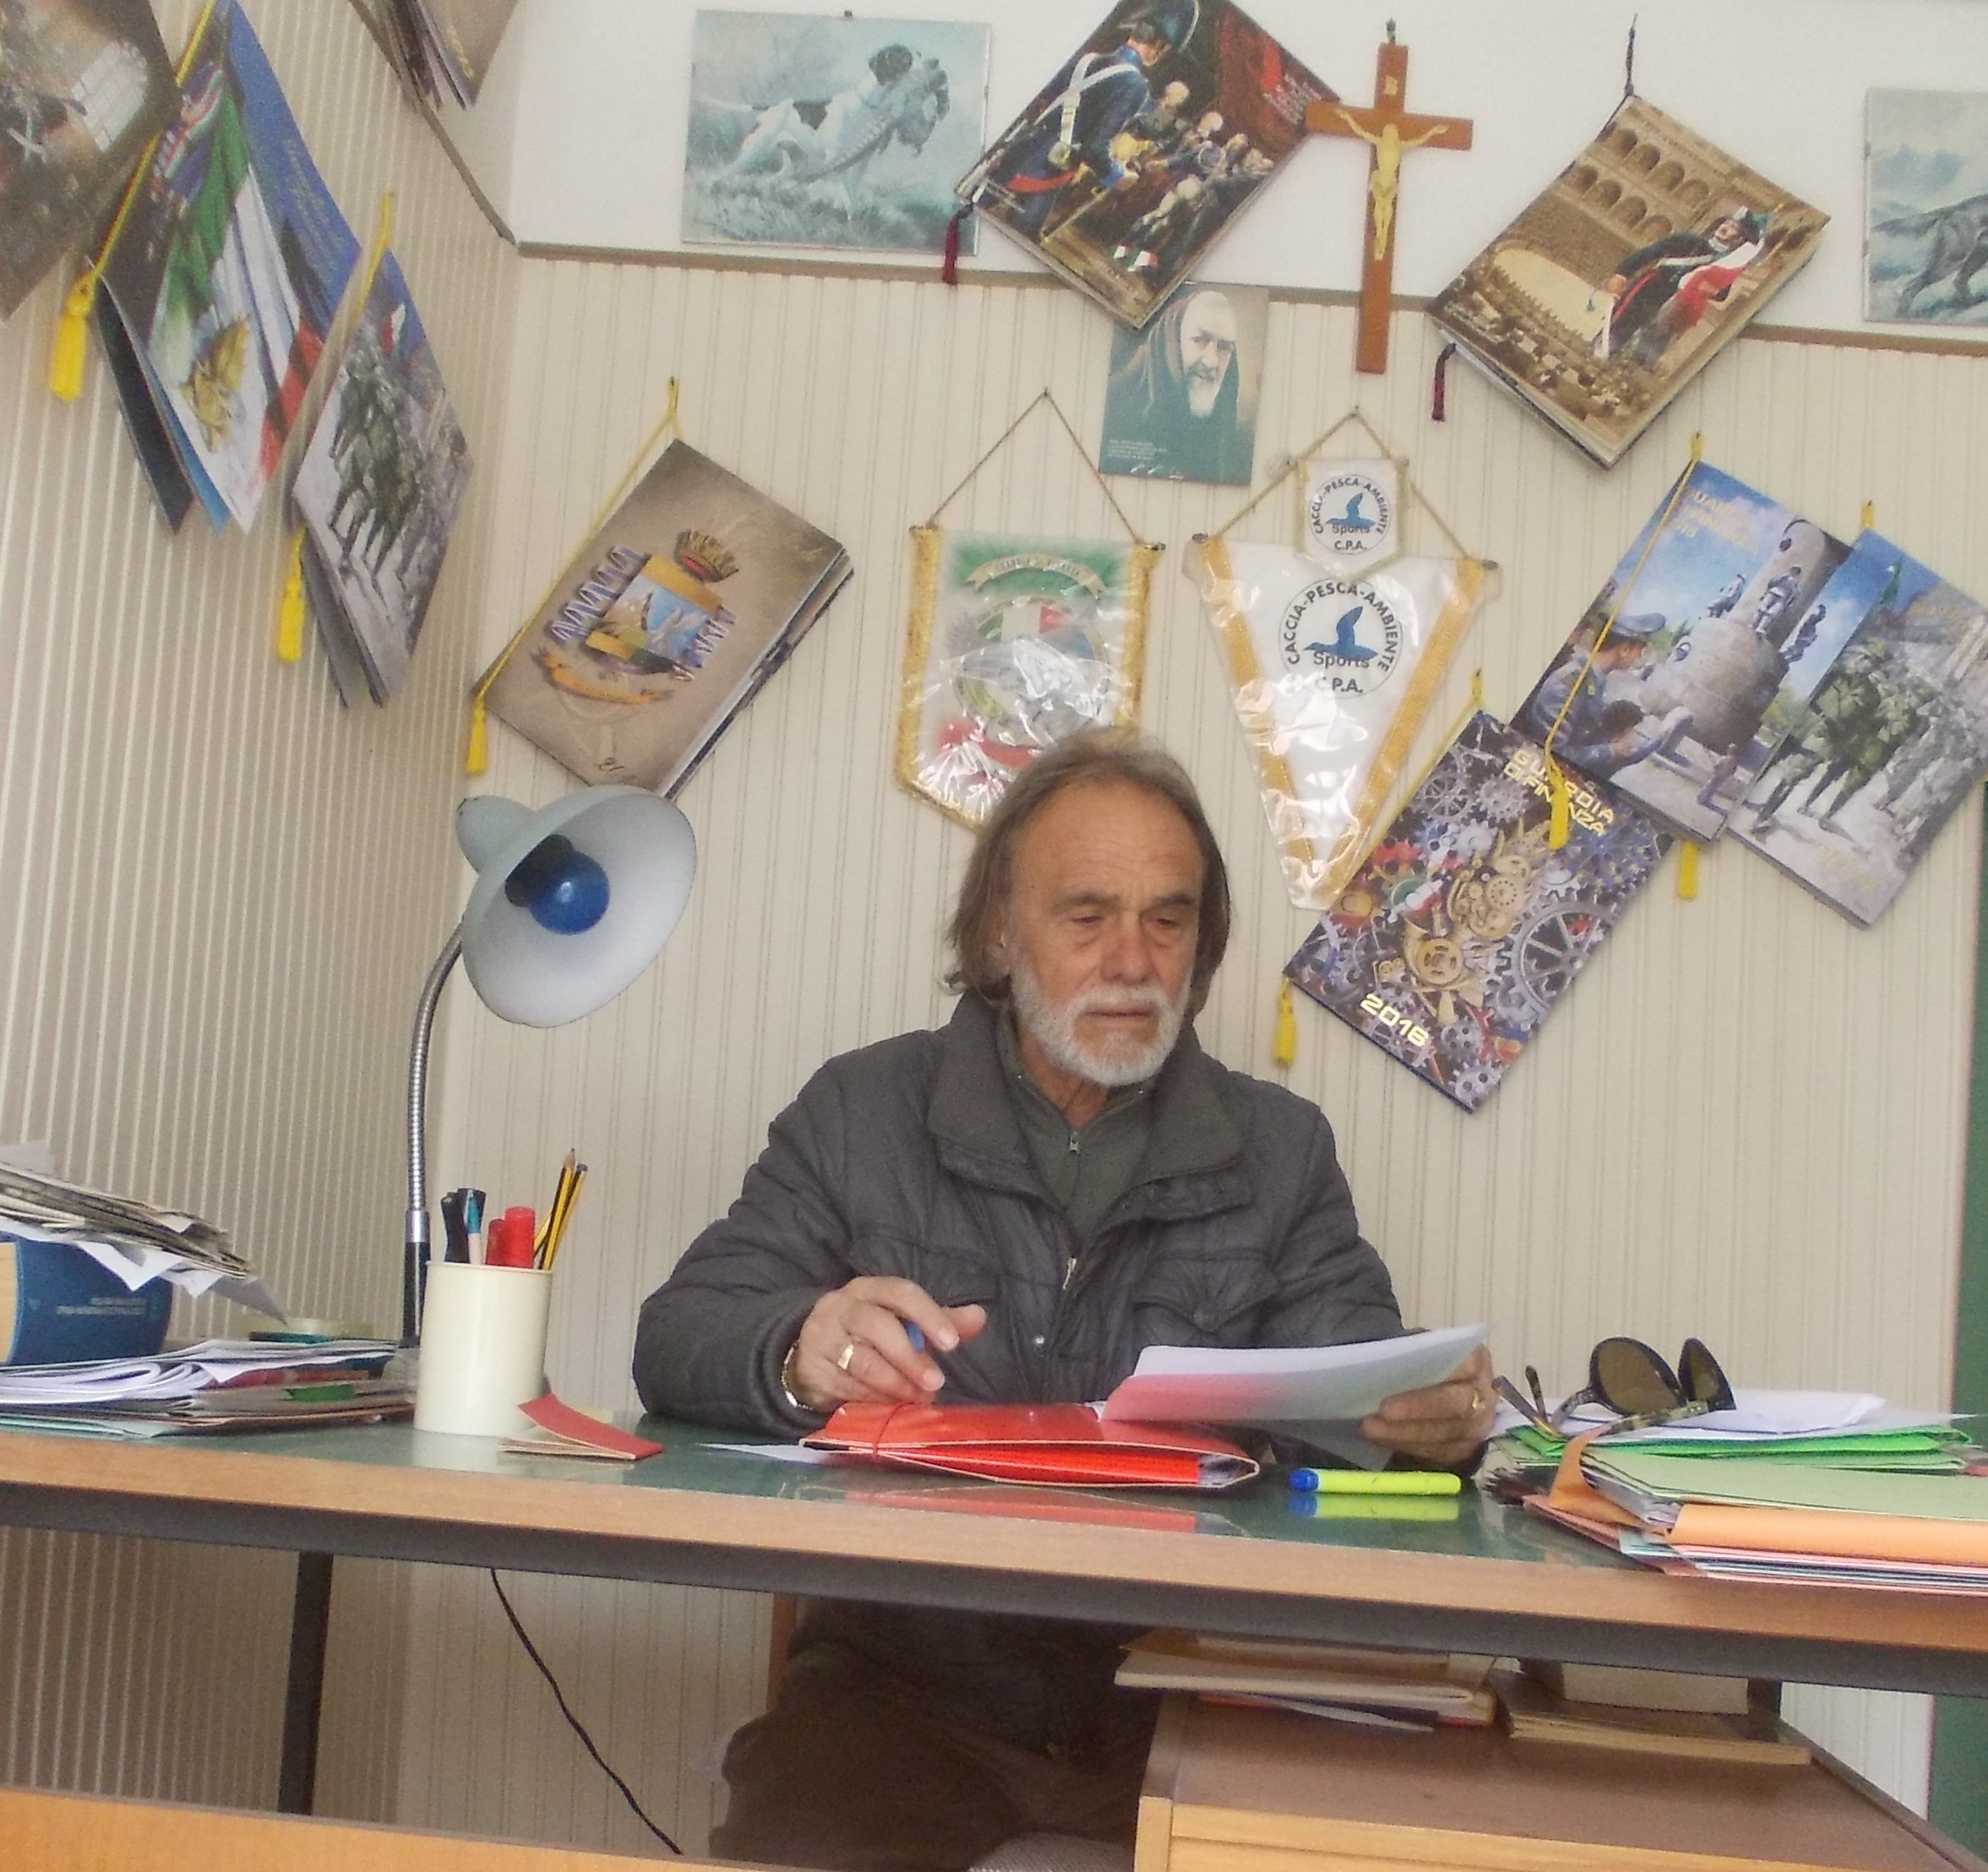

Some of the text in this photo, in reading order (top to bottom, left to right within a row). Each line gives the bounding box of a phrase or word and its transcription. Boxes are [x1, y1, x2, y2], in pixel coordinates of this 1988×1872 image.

[1334, 540, 1367, 550] C.P.A.
[1283, 581, 1398, 672] CACCIA-PESCA-AMBIENTE
[1313, 651, 1370, 668] Sports
[1315, 677, 1364, 694] CP.A.
[1512, 749, 1614, 824] GURDIA
[1522, 775, 1604, 836] FINNZA
[1360, 993, 1429, 1047] 2016
